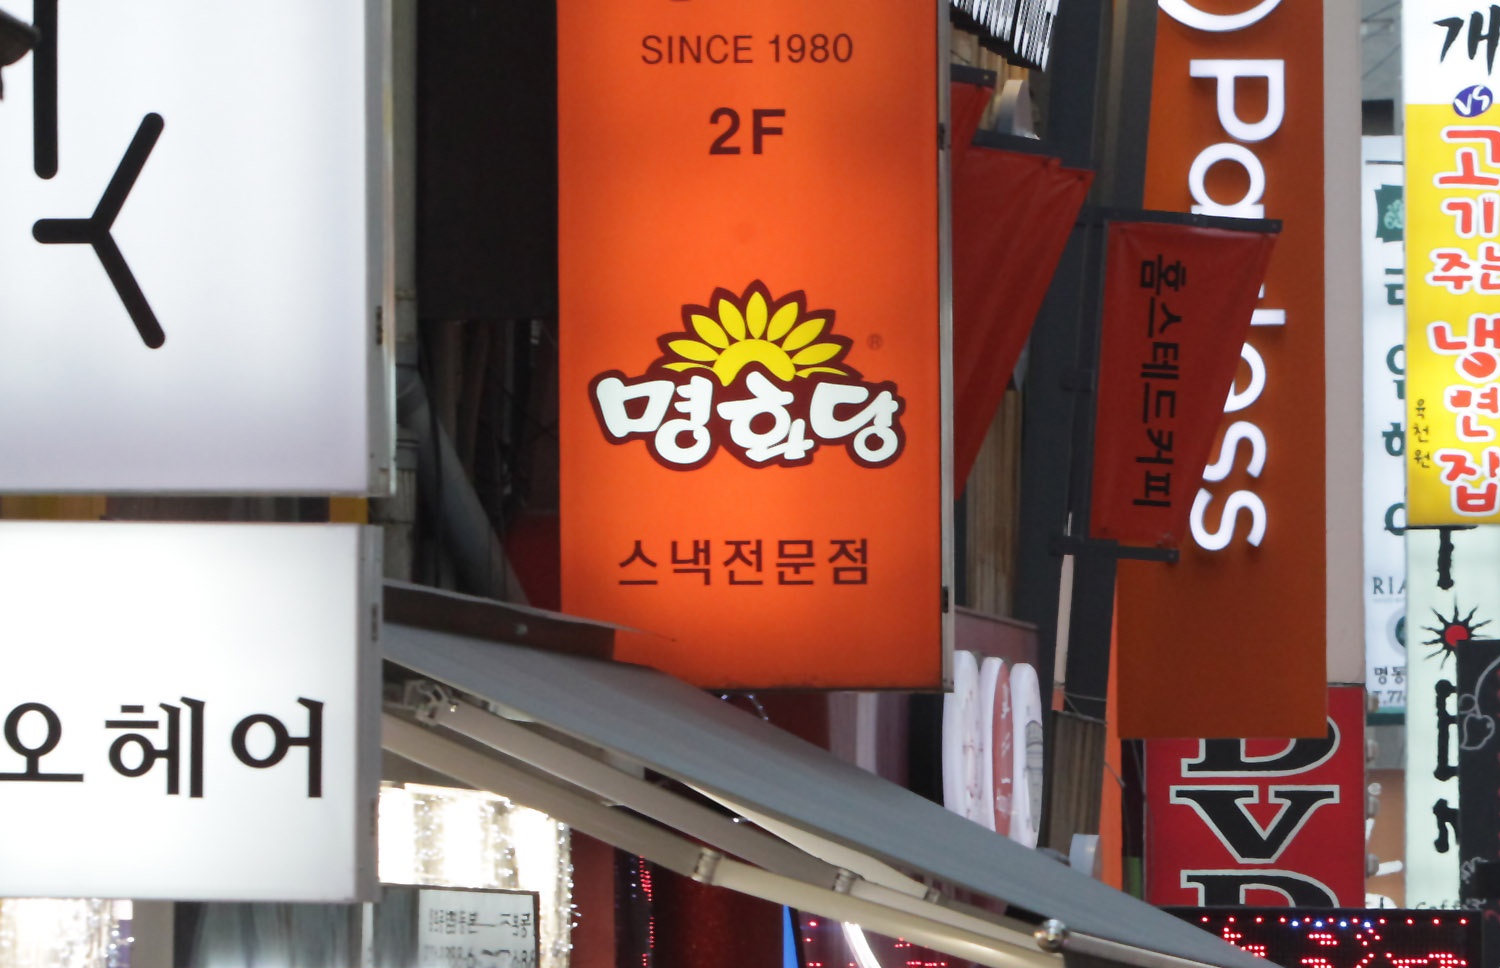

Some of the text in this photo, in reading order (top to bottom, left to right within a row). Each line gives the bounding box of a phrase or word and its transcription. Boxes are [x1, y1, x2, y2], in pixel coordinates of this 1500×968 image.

[641, 33, 854, 65] SINCE 1980
[708, 106, 787, 156] 2F
[1189, 58, 1286, 552] Pass
[1132, 253, 1187, 508] 홈스테드커피
[595, 370, 900, 466] 명화당
[617, 537, 869, 587] 스낵전문점
